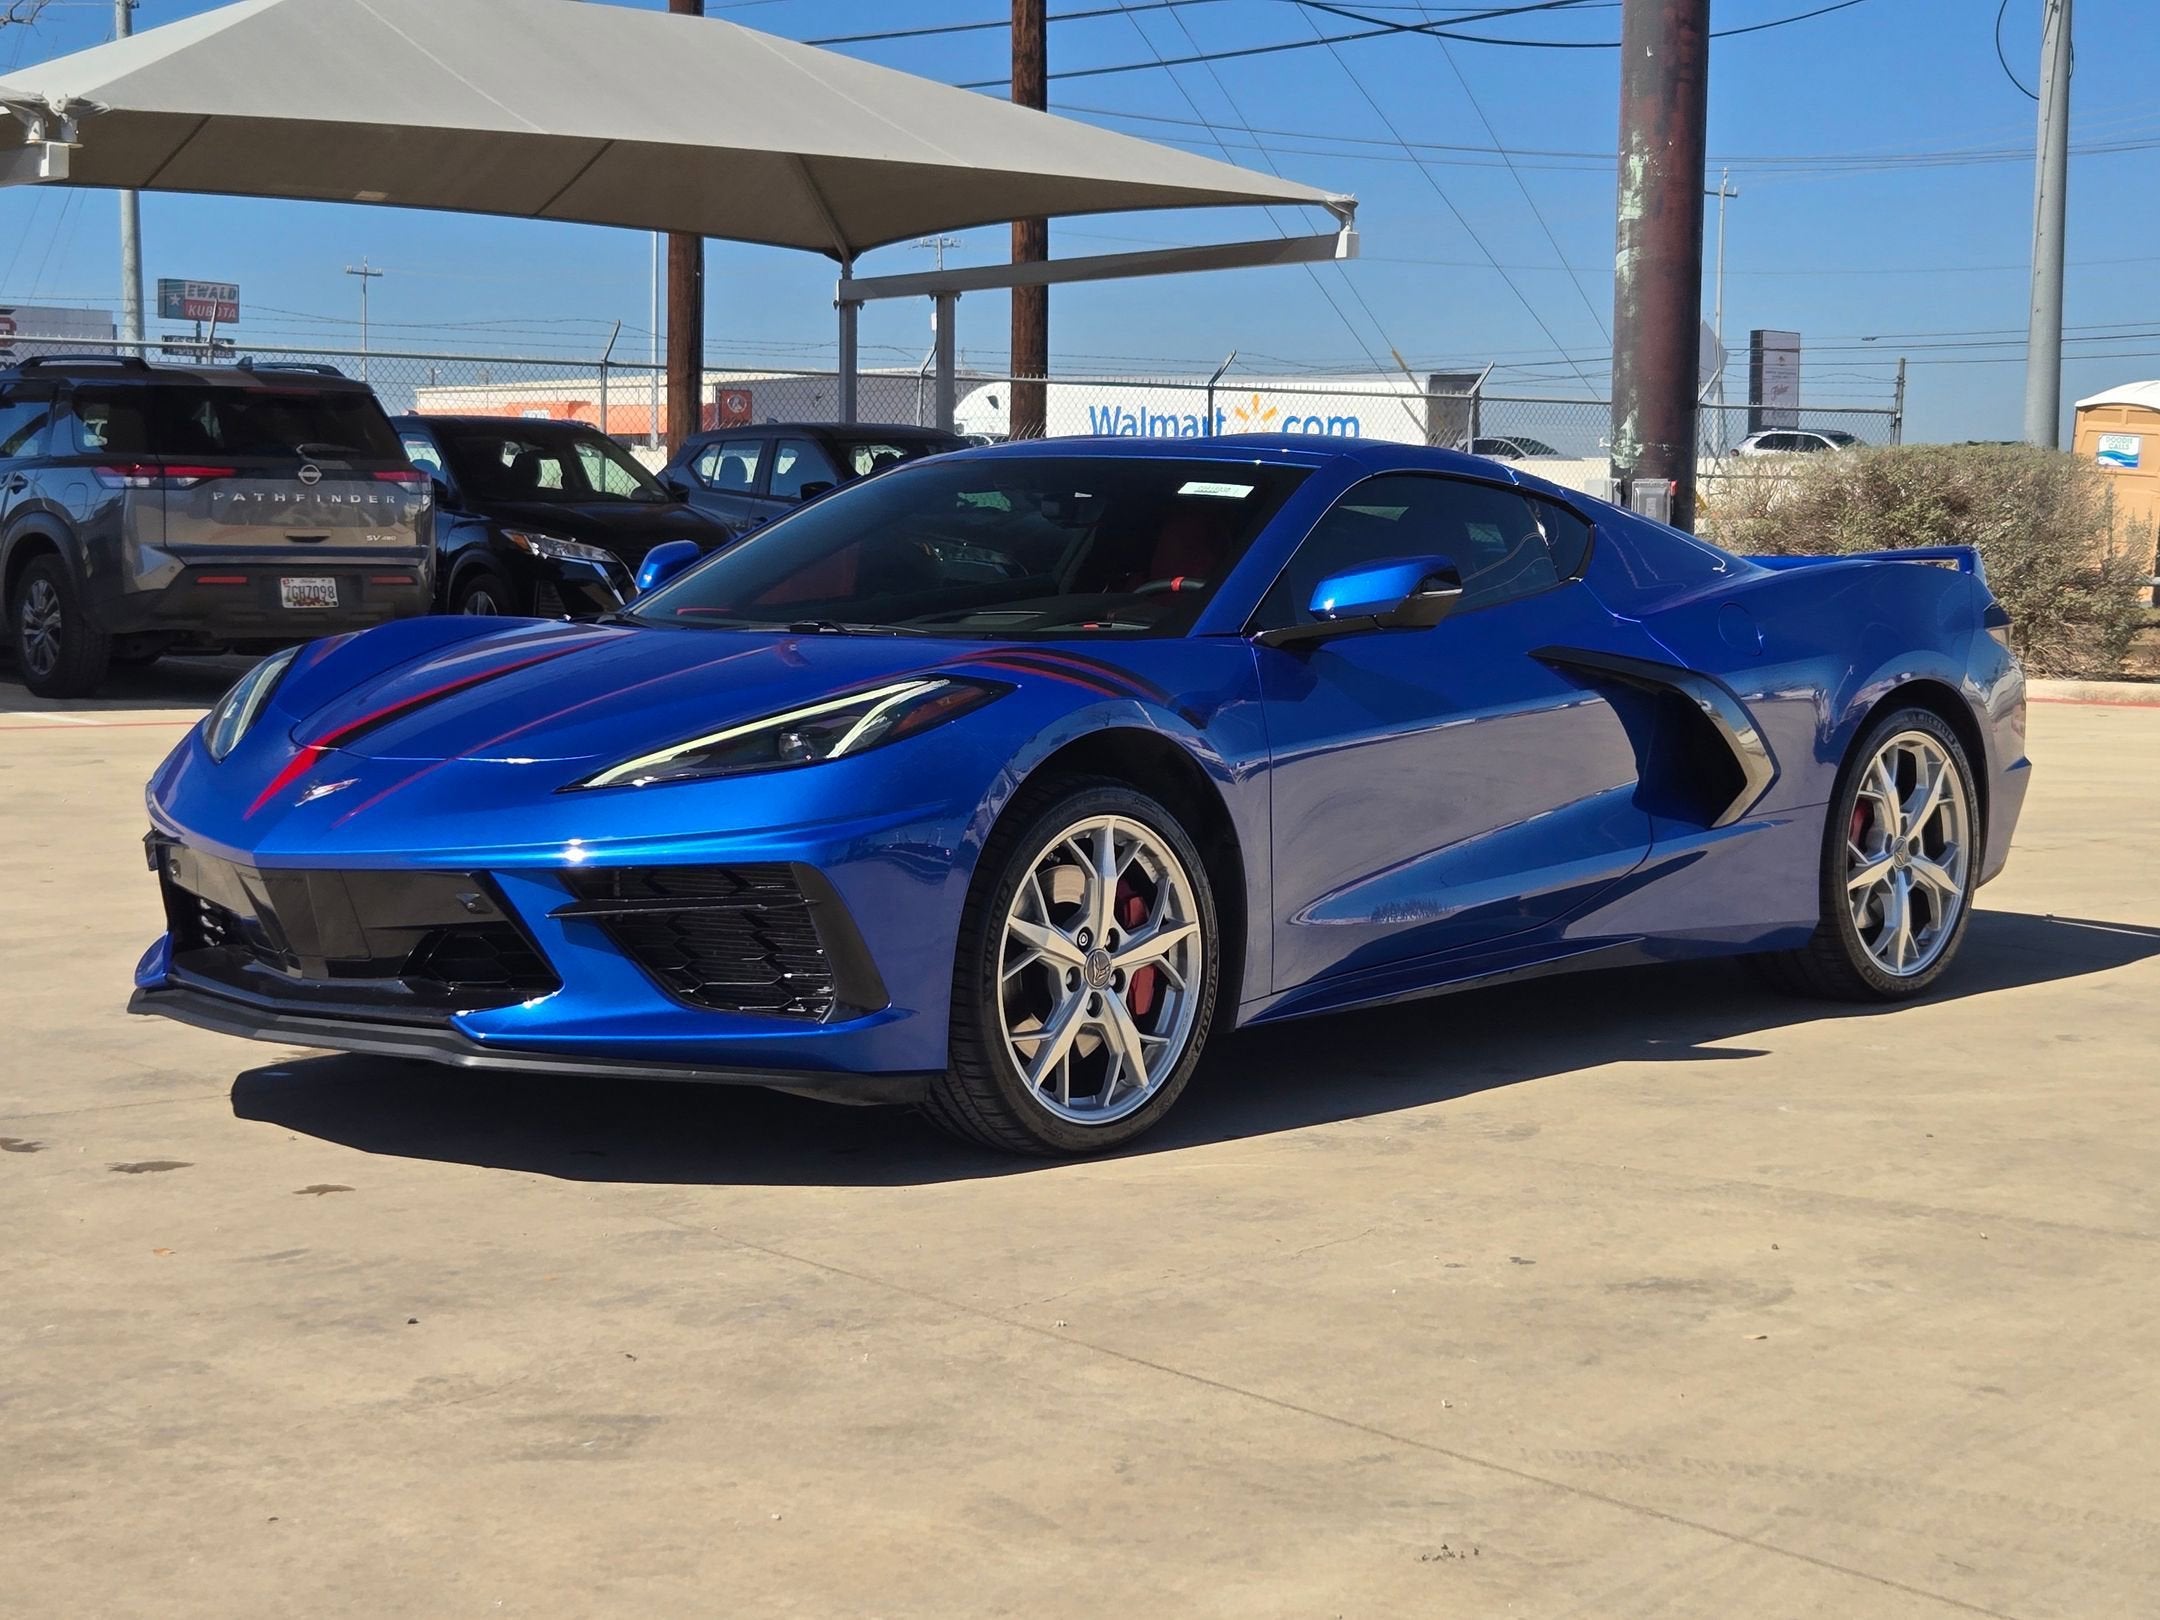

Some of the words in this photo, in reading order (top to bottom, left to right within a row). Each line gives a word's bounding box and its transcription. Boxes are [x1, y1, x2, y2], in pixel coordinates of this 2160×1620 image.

[187, 284, 237, 300] EWALD
[1089, 405, 1227, 437] Walmart
[1282, 415, 1360, 438] com
[212, 492, 396, 504] PATHFINDER
[1195, 962, 1217, 1050] MICHELIN
